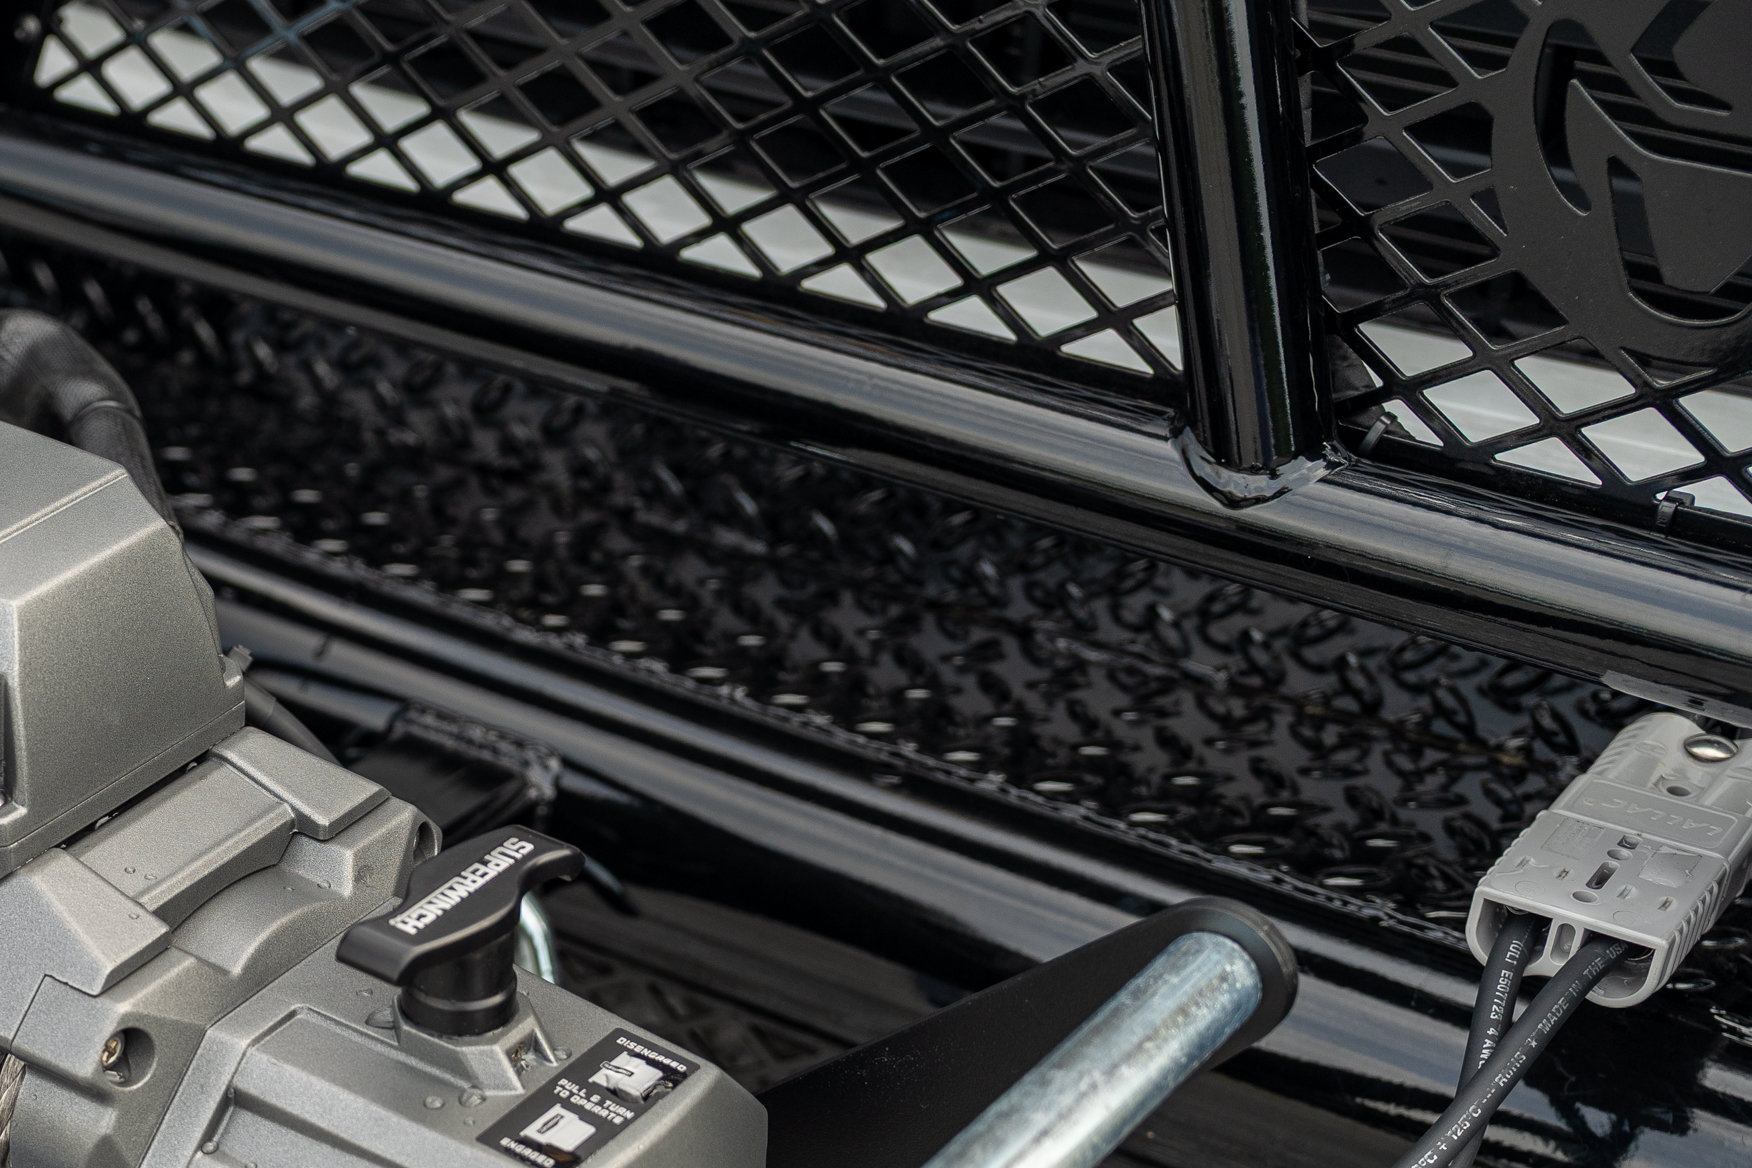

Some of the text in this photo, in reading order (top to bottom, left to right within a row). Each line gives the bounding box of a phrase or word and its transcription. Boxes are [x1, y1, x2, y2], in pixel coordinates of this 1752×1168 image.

[389, 837, 535, 936] SUPERWINCH
[1537, 997, 1570, 1034] MADE
[1569, 980, 1584, 996] IN
[1582, 956, 1606, 980] THE
[1608, 941, 1629, 959] USA
[616, 1037, 687, 1072] DISENGAGED
[553, 1086, 624, 1125] TO OPERATE
[557, 1078, 586, 1097] PULL
[603, 1100, 635, 1120] TURN
[499, 1137, 556, 1168] ENGAGED
